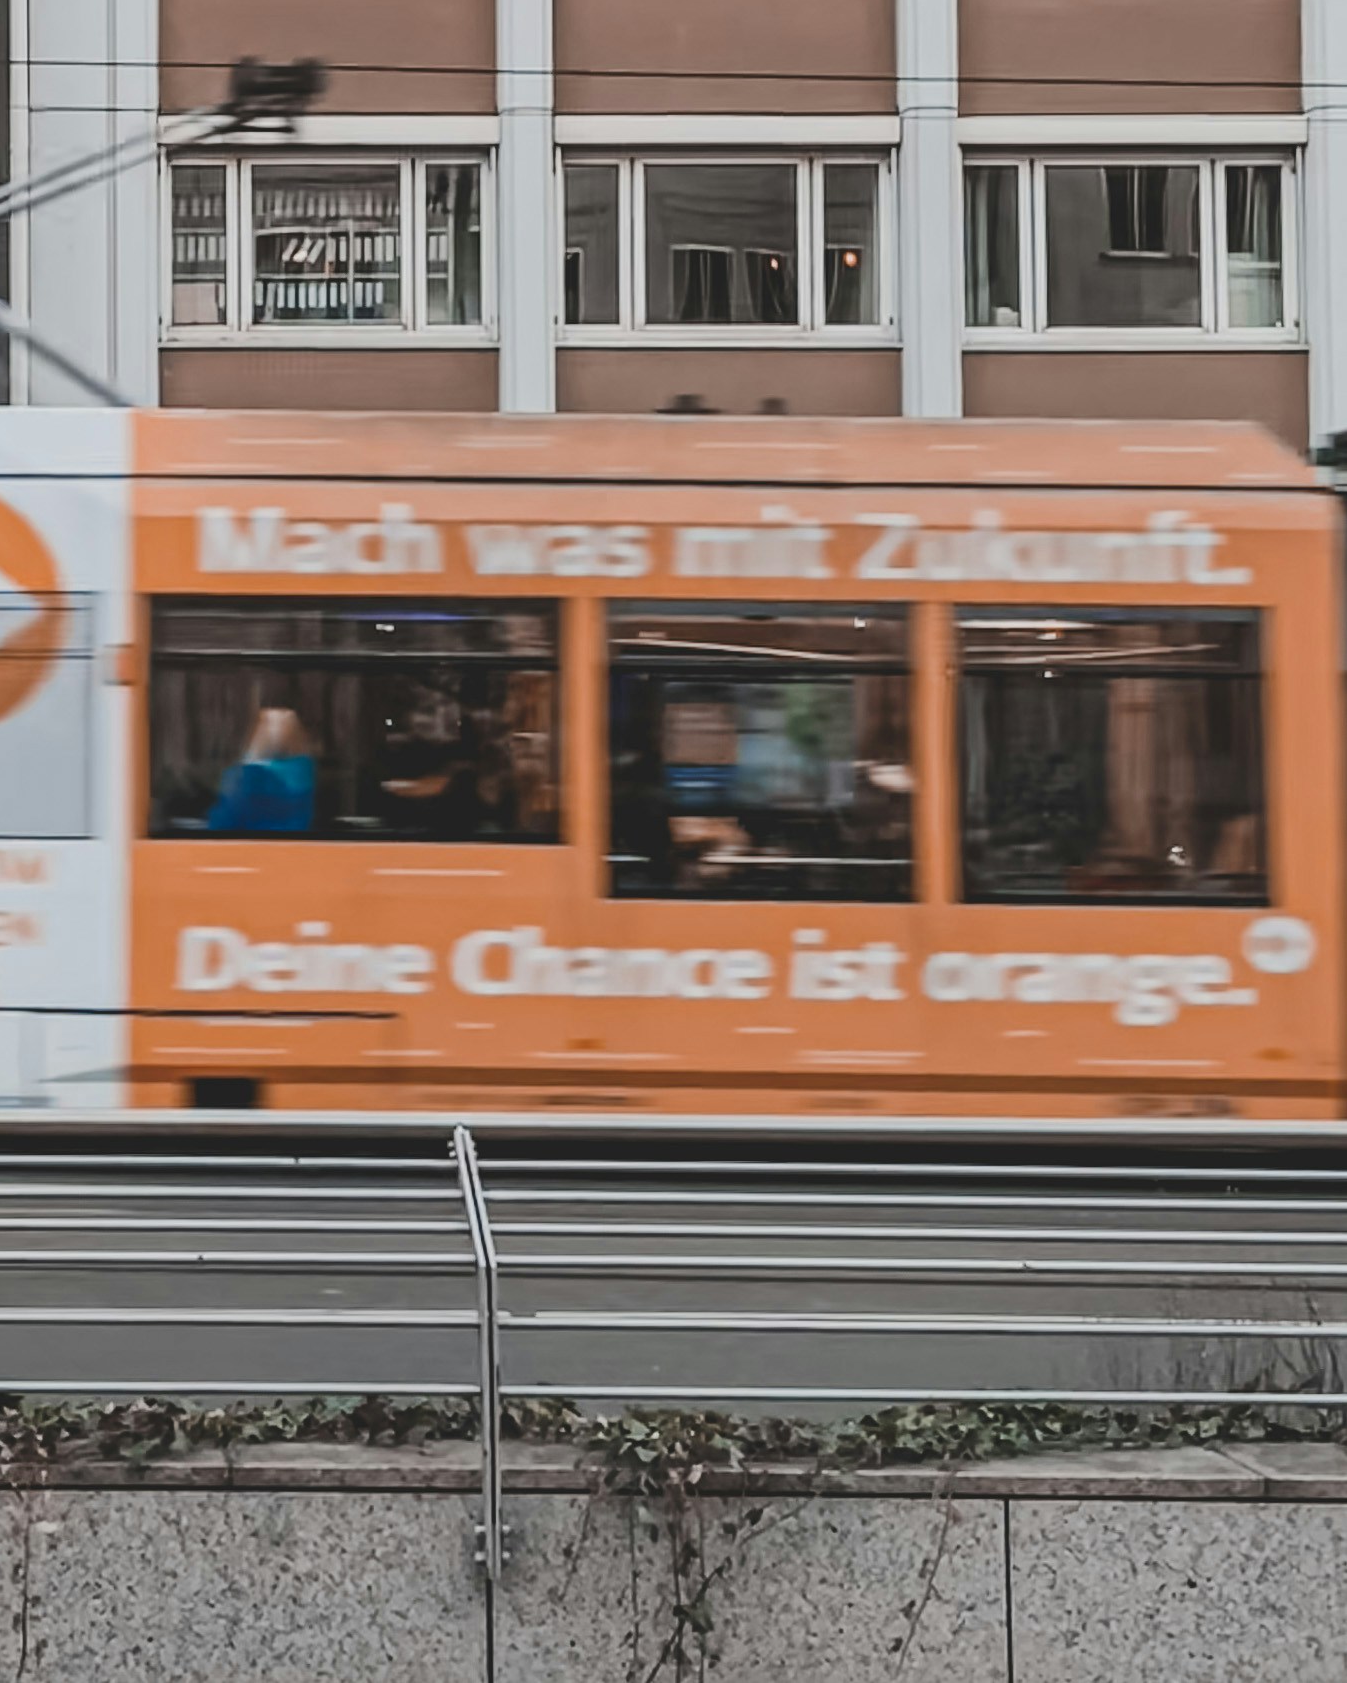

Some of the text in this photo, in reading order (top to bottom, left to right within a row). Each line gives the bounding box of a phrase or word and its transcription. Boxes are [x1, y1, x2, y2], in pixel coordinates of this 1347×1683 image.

[195, 503, 1253, 586] Mach was mit Zukunft.
[175, 921, 1258, 1027] Deine Chance ist orange.
